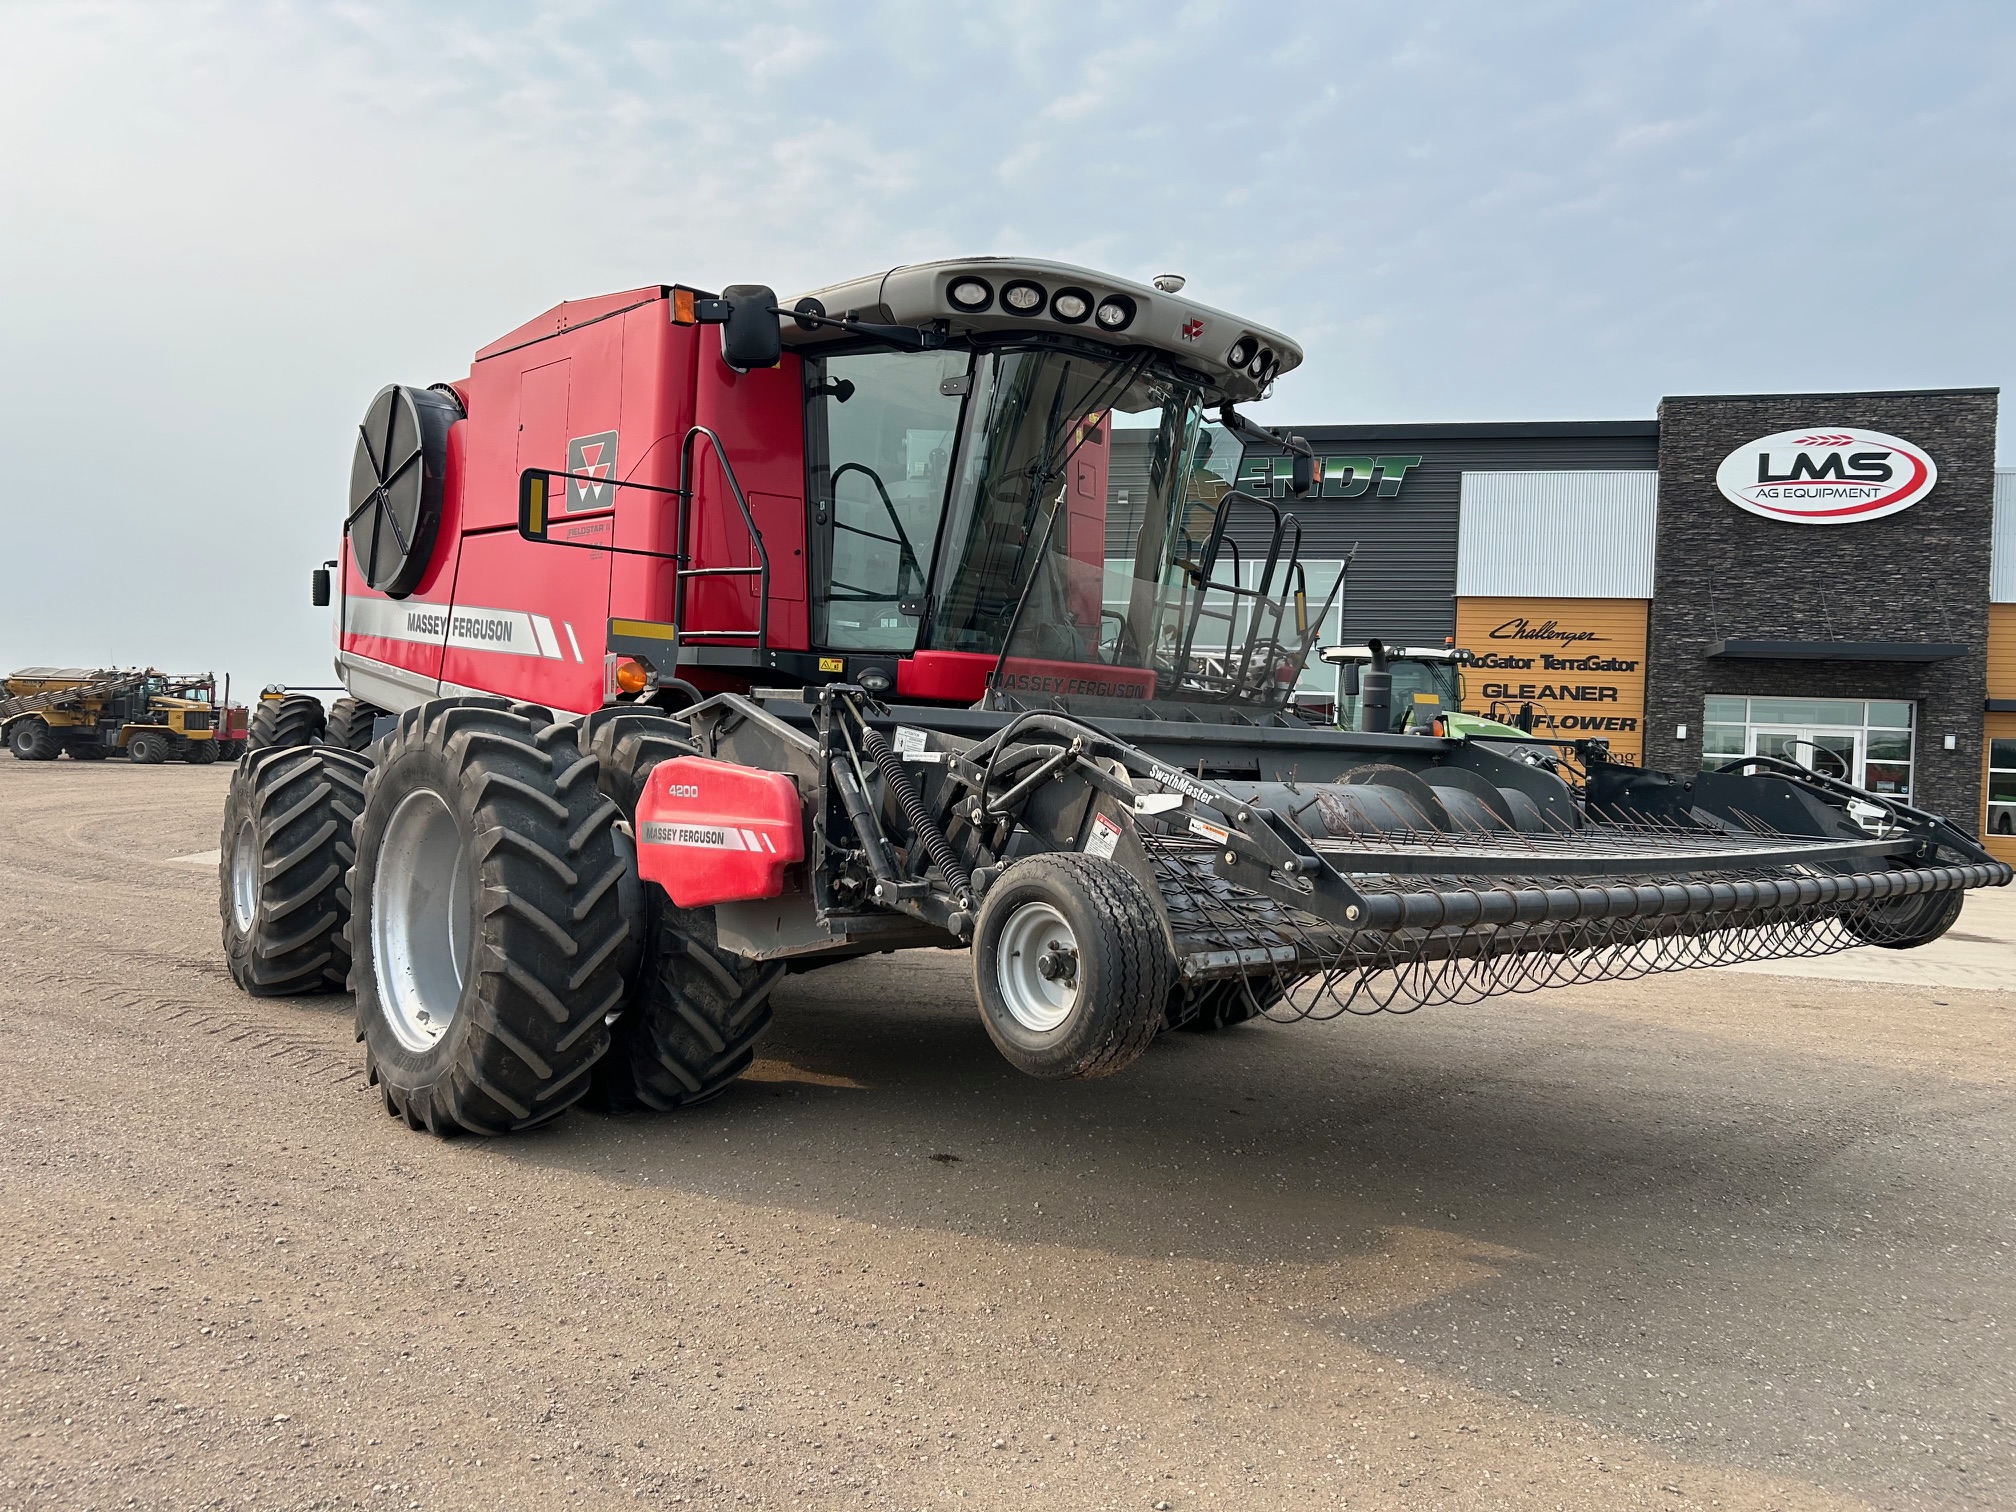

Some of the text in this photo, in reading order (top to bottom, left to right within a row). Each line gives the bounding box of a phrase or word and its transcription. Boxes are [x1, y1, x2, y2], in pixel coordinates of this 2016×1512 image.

[1757, 451, 1893, 483] LMS
[1755, 487, 1881, 498] AG EQUIPMENT
[568, 524, 604, 536] FIELDSTAR
[407, 612, 513, 642] MASSEY FERGUSON
[1488, 618, 1613, 648] Challenger
[1540, 654, 1639, 672] TerraGator
[1067, 678, 1147, 699] FERGUSON
[1482, 683, 1618, 701] GLEANER
[669, 785, 698, 797] 4200
[1150, 765, 1213, 804] SwathMaster
[646, 827, 724, 845] MASSEY FERGUSON
